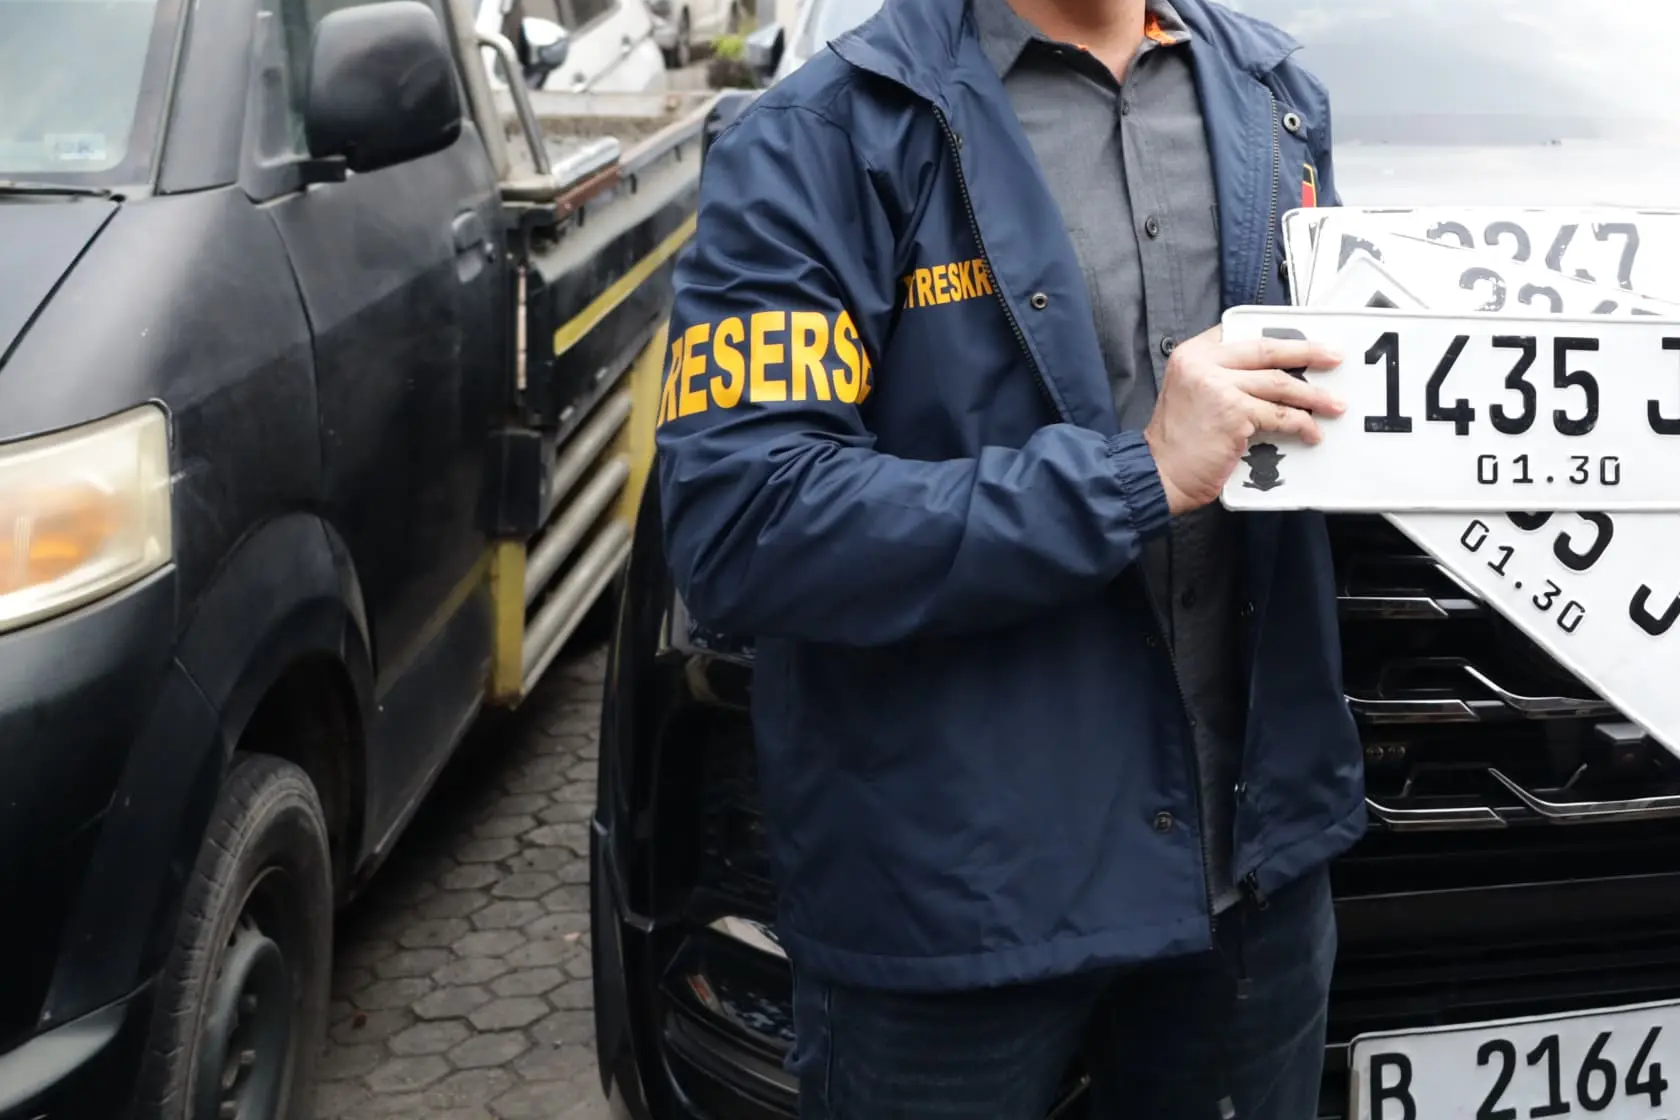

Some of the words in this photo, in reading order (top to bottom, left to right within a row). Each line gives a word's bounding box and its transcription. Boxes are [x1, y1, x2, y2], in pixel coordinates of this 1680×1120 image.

[1364, 331, 1601, 437] 1435
[1476, 453, 1621, 487] 01.30
[1460, 519, 1586, 633] 01.30
[1475, 1026, 1669, 1120] 2164
